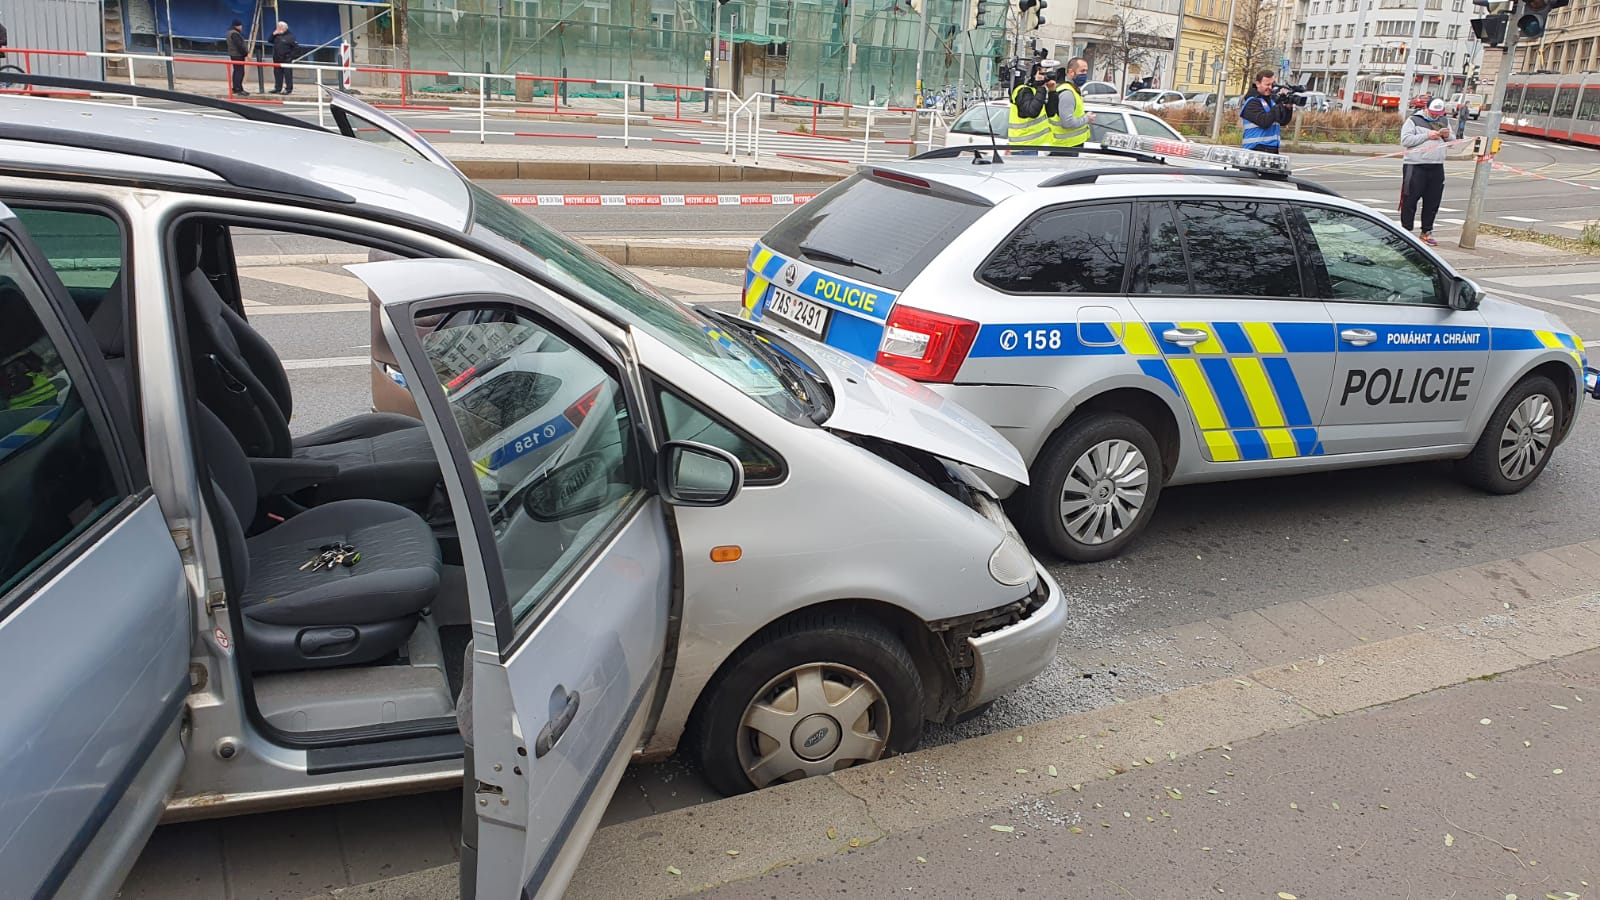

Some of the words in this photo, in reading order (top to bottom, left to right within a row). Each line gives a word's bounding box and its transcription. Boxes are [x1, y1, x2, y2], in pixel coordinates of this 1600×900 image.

[771, 291, 792, 315] 7AS
[794, 302, 822, 330] 2491
[814, 278, 878, 312] POLICIE
[1024, 330, 1062, 350] 158
[1386, 331, 1432, 344] POMÁHAT
[1434, 334, 1440, 344] A
[1442, 331, 1480, 344] CHRÁNIT
[1340, 366, 1474, 406] POLICIE
